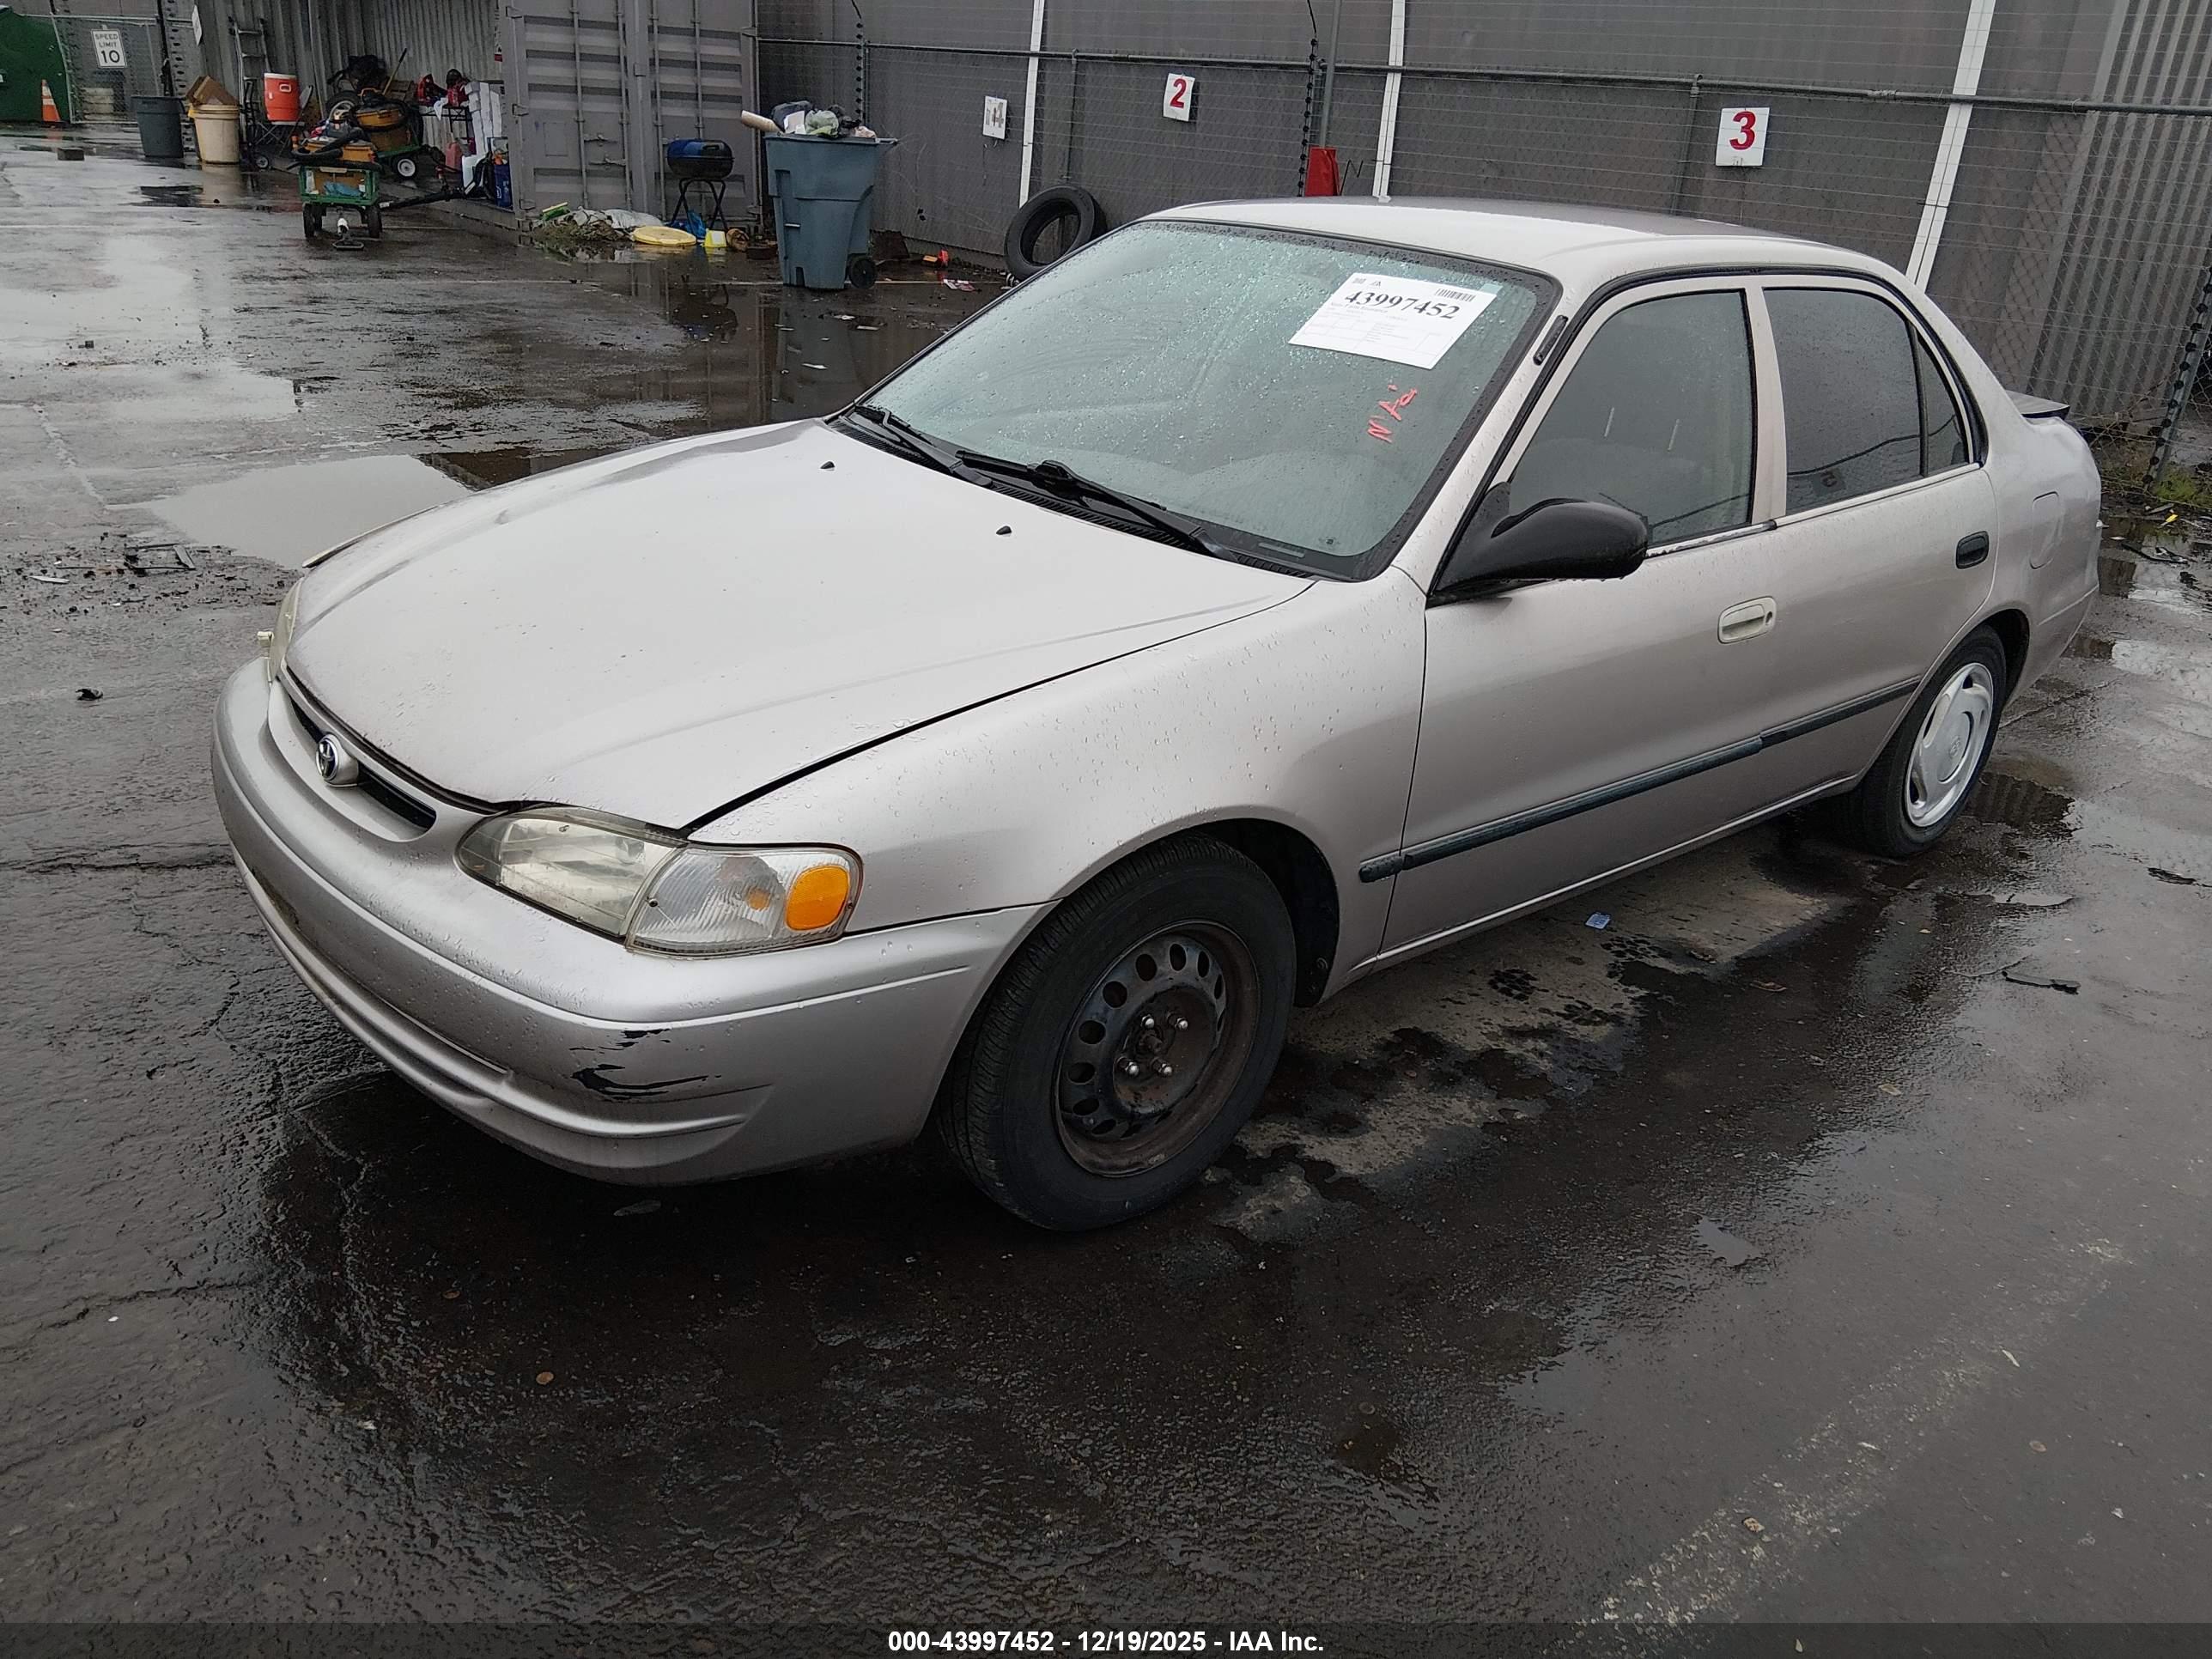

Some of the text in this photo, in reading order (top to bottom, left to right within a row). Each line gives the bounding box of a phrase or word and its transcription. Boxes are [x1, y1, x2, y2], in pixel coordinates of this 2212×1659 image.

[101, 50, 120, 64] 10
[1170, 77, 1188, 109] 2
[1729, 110, 1757, 151] 3
[1345, 290, 1461, 319] 43997452
